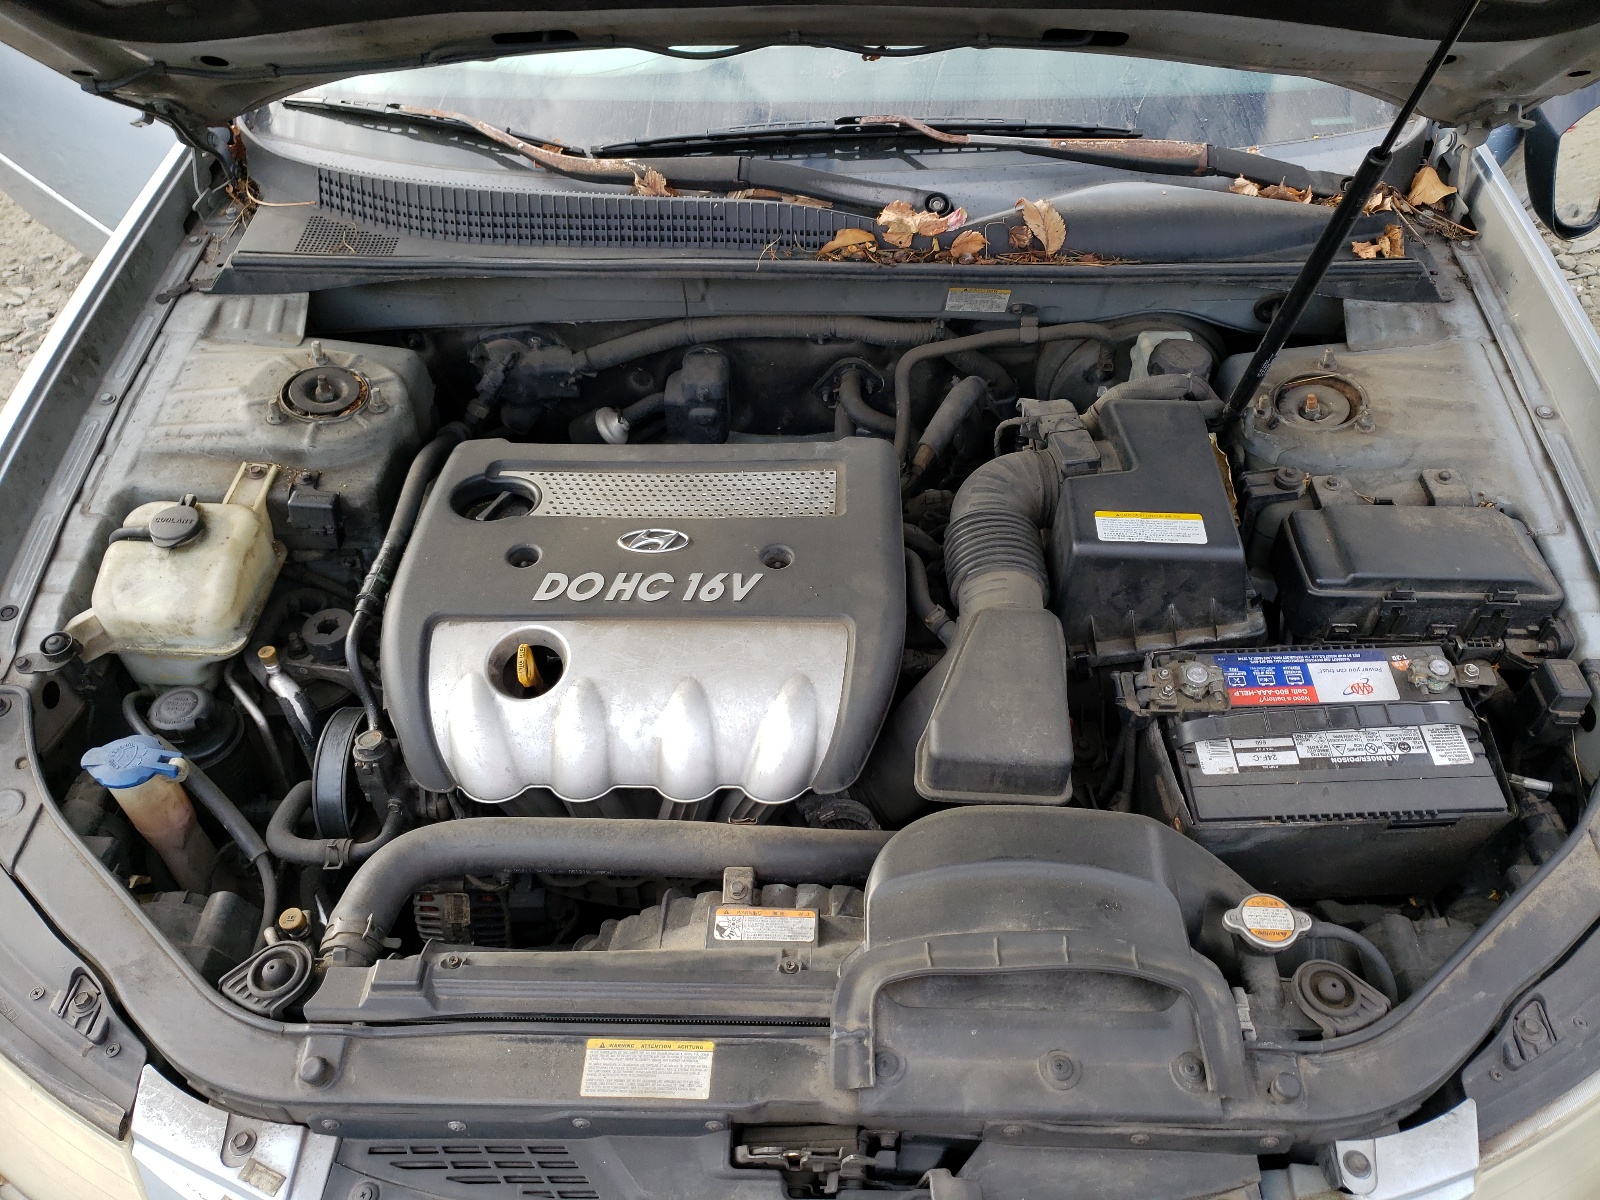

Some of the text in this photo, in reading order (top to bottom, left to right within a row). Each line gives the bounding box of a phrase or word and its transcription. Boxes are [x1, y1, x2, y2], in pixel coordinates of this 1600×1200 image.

[532, 572, 764, 602] DOHC 16V
[1233, 689, 1289, 697] 800-AAA-HELP
[1351, 683, 1373, 695] AAA
[1259, 695, 1286, 703] battery?
[1330, 755, 1393, 763] DANGER/POISON
